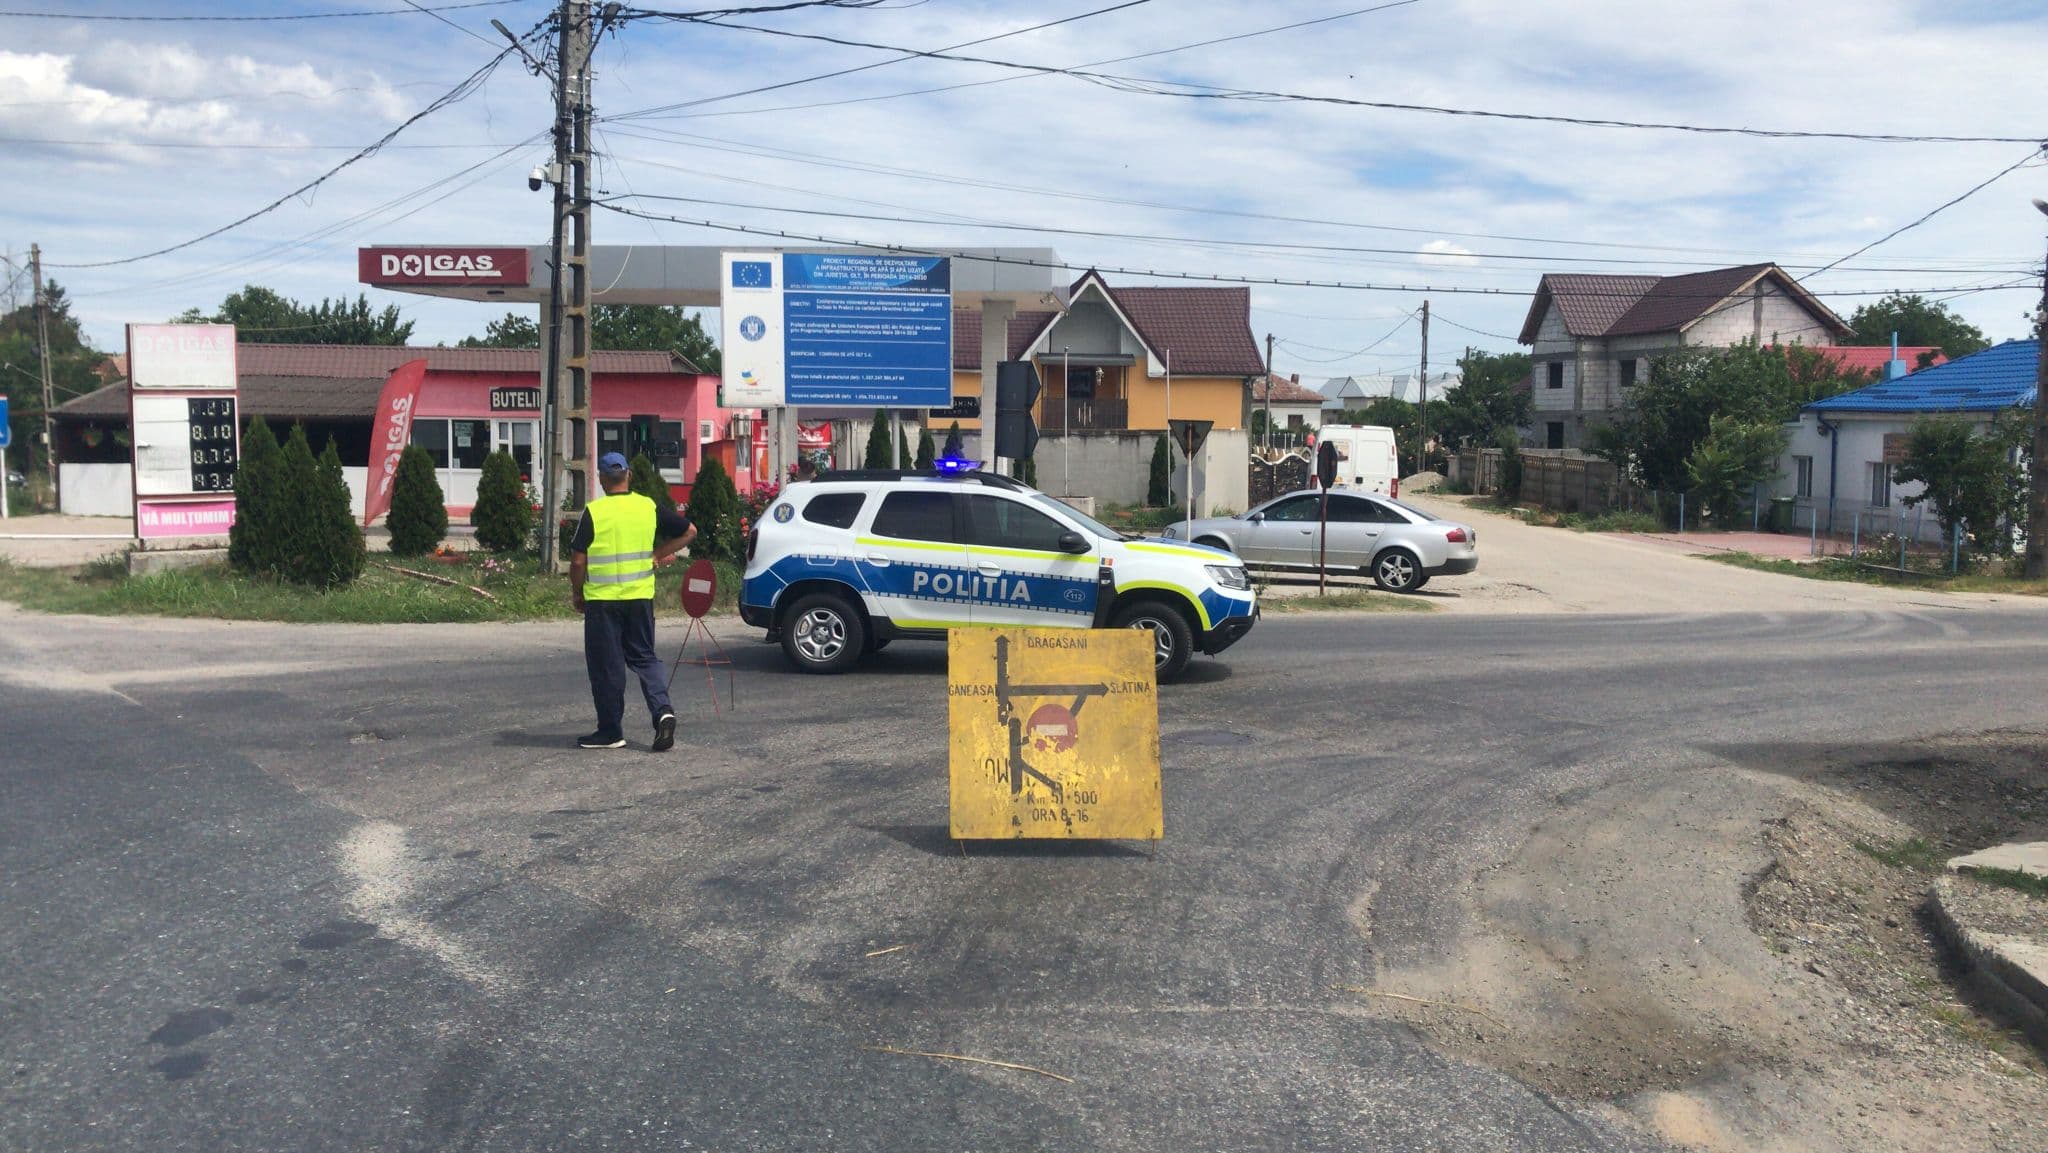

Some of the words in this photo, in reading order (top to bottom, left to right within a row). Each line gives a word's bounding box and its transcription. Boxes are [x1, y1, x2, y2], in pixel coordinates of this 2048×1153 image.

[381, 254, 502, 277] DOLGAS
[1027, 636, 1088, 649] DRAGASANI
[1110, 681, 1151, 694] SLATINA
